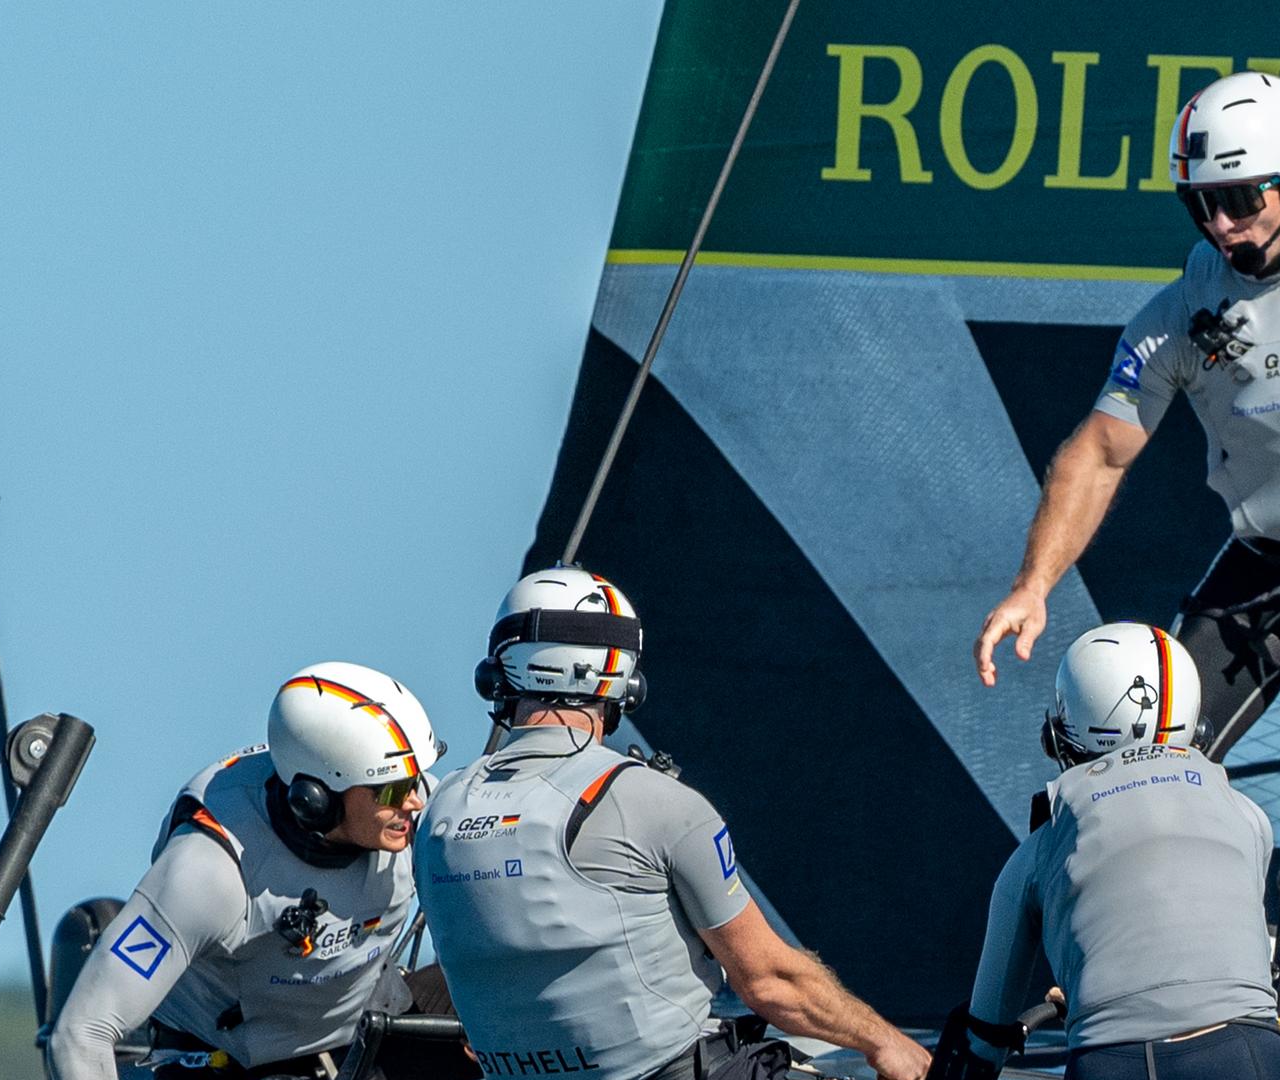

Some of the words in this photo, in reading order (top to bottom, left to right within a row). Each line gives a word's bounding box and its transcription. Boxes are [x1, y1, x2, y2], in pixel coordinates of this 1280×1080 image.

[1221, 160, 1241, 170] WIP
[535, 676, 555, 685] WIP
[1096, 739, 1116, 747] WIP
[1121, 745, 1166, 759] GER
[1122, 754, 1161, 765] SAILGP
[1091, 779, 1148, 802] Deutsche
[1150, 774, 1181, 784] Bank
[457, 815, 499, 832] GER
[453, 831, 489, 841] SAILGP
[490, 827, 517, 838] TEAM
[431, 872, 471, 884] Deutsche
[473, 868, 501, 881] Bank
[321, 923, 362, 949] GER
[475, 1046, 600, 1076] BITHELL
